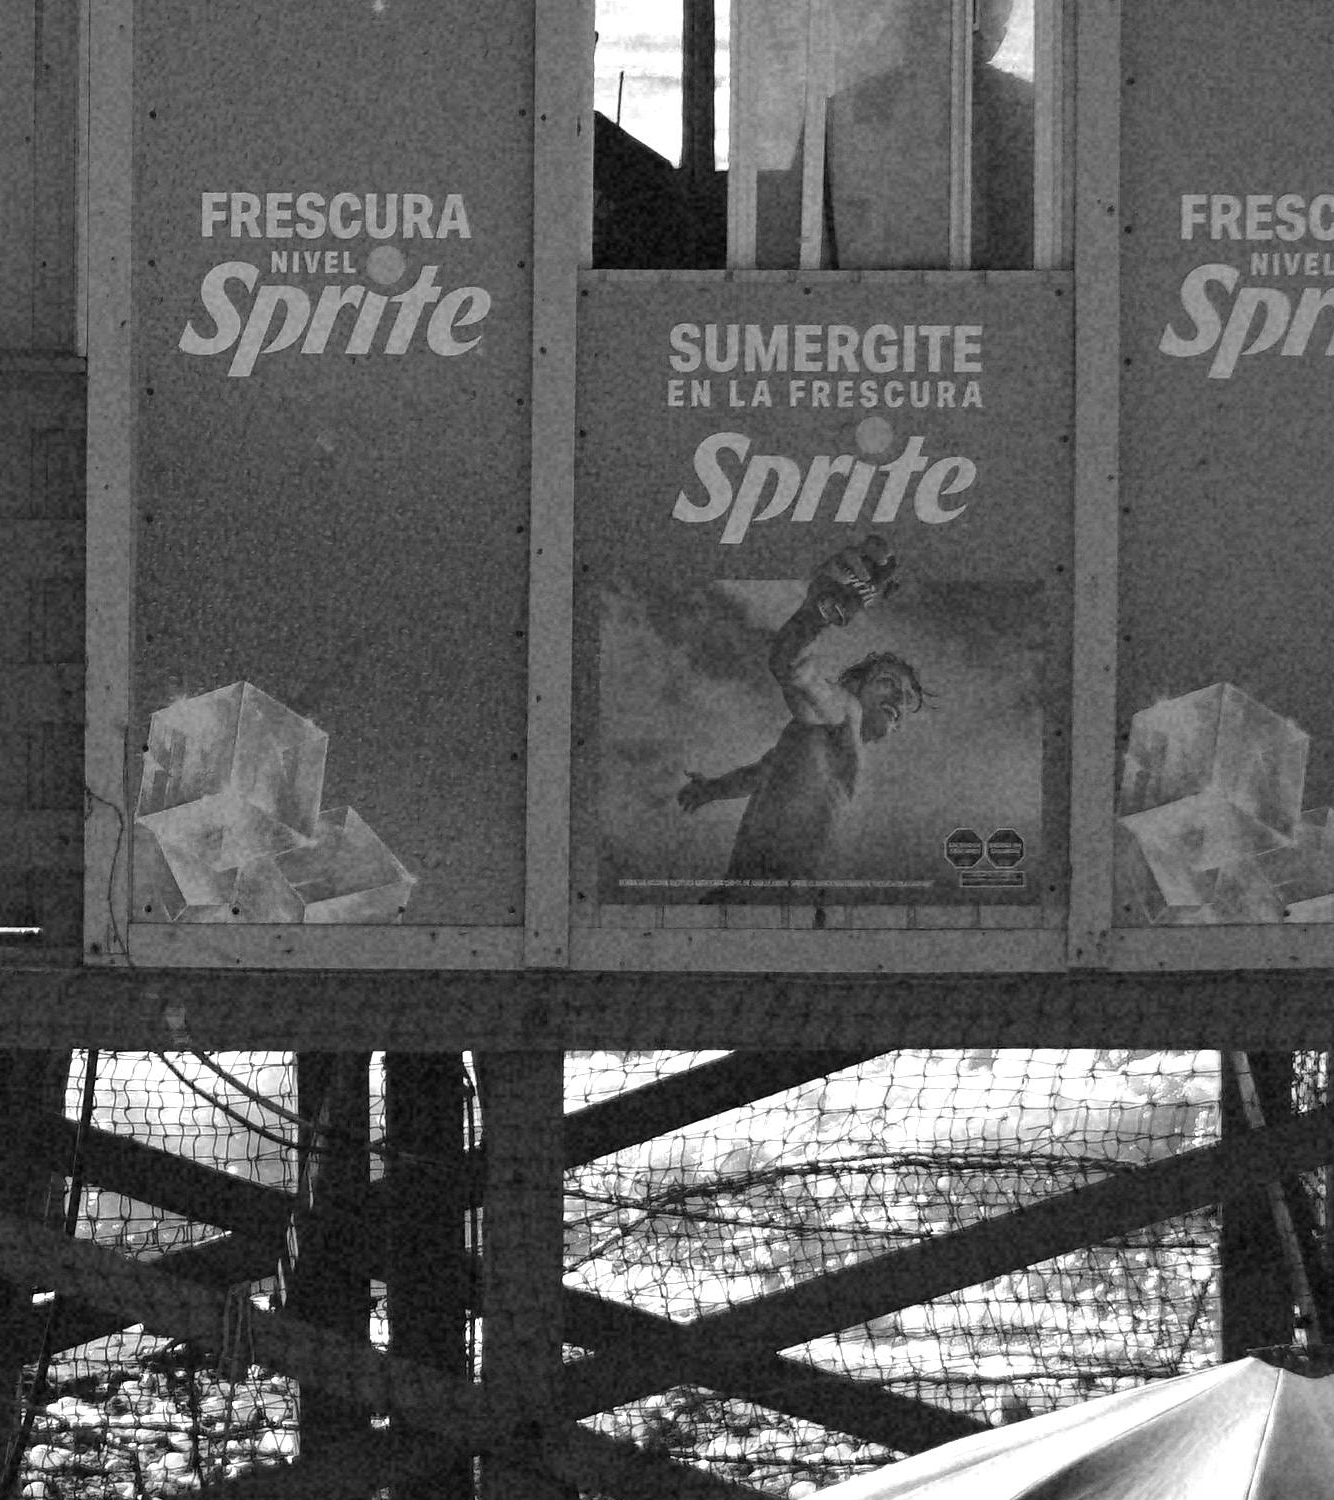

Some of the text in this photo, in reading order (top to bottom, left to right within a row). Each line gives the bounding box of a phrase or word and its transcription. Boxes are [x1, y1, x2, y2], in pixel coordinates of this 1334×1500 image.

[200, 191, 472, 240] FRESCURA
[270, 250, 357, 275] NIVEL
[177, 245, 493, 377] Sprite
[668, 323, 984, 374] SUMERGITE
[667, 379, 984, 409] EN LA FRESCURA
[671, 416, 978, 545] Sprite
